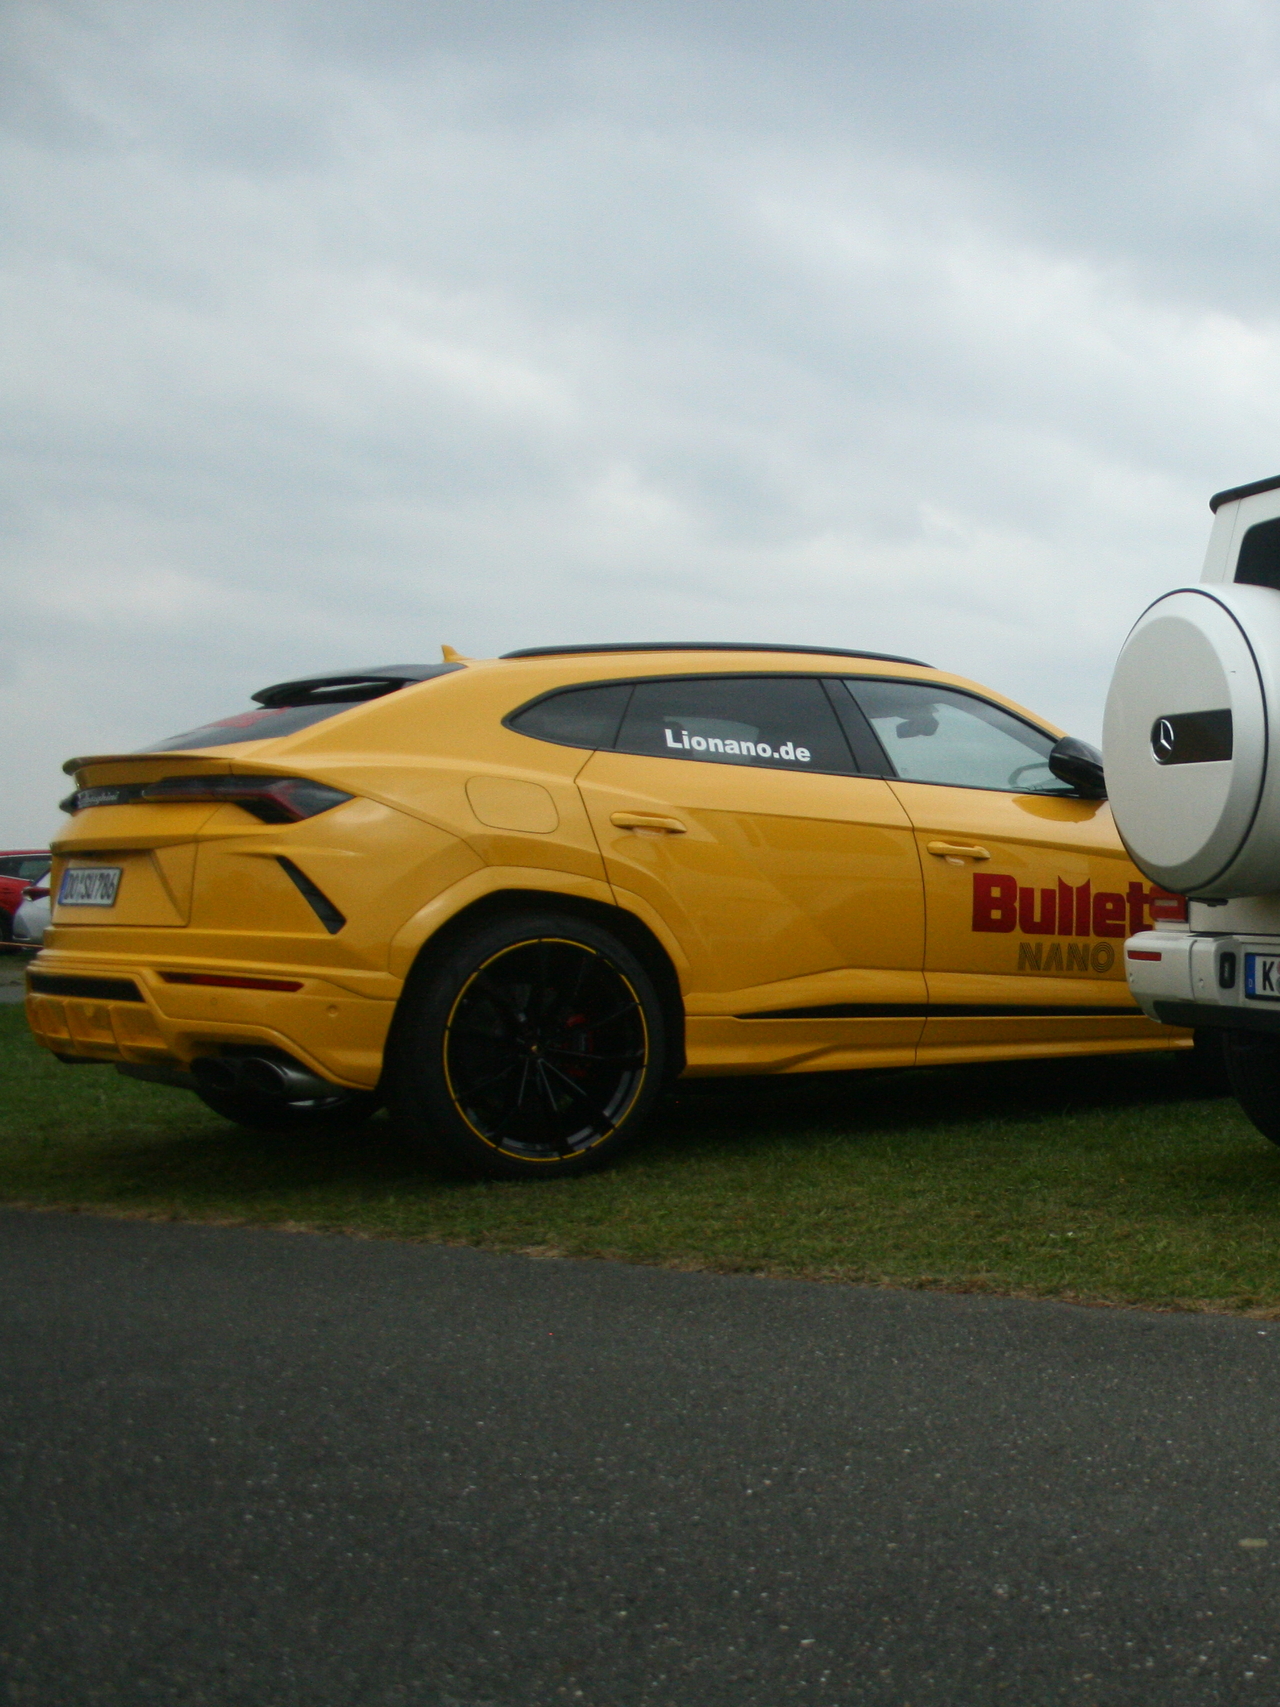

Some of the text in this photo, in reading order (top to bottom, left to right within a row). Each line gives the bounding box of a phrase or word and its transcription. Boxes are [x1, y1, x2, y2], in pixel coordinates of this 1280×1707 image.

[664, 728, 811, 762] Lionano.de
[971, 872, 1153, 939] Bullet
[1017, 941, 1115, 974] NANO
[1262, 960, 1275, 992] K
